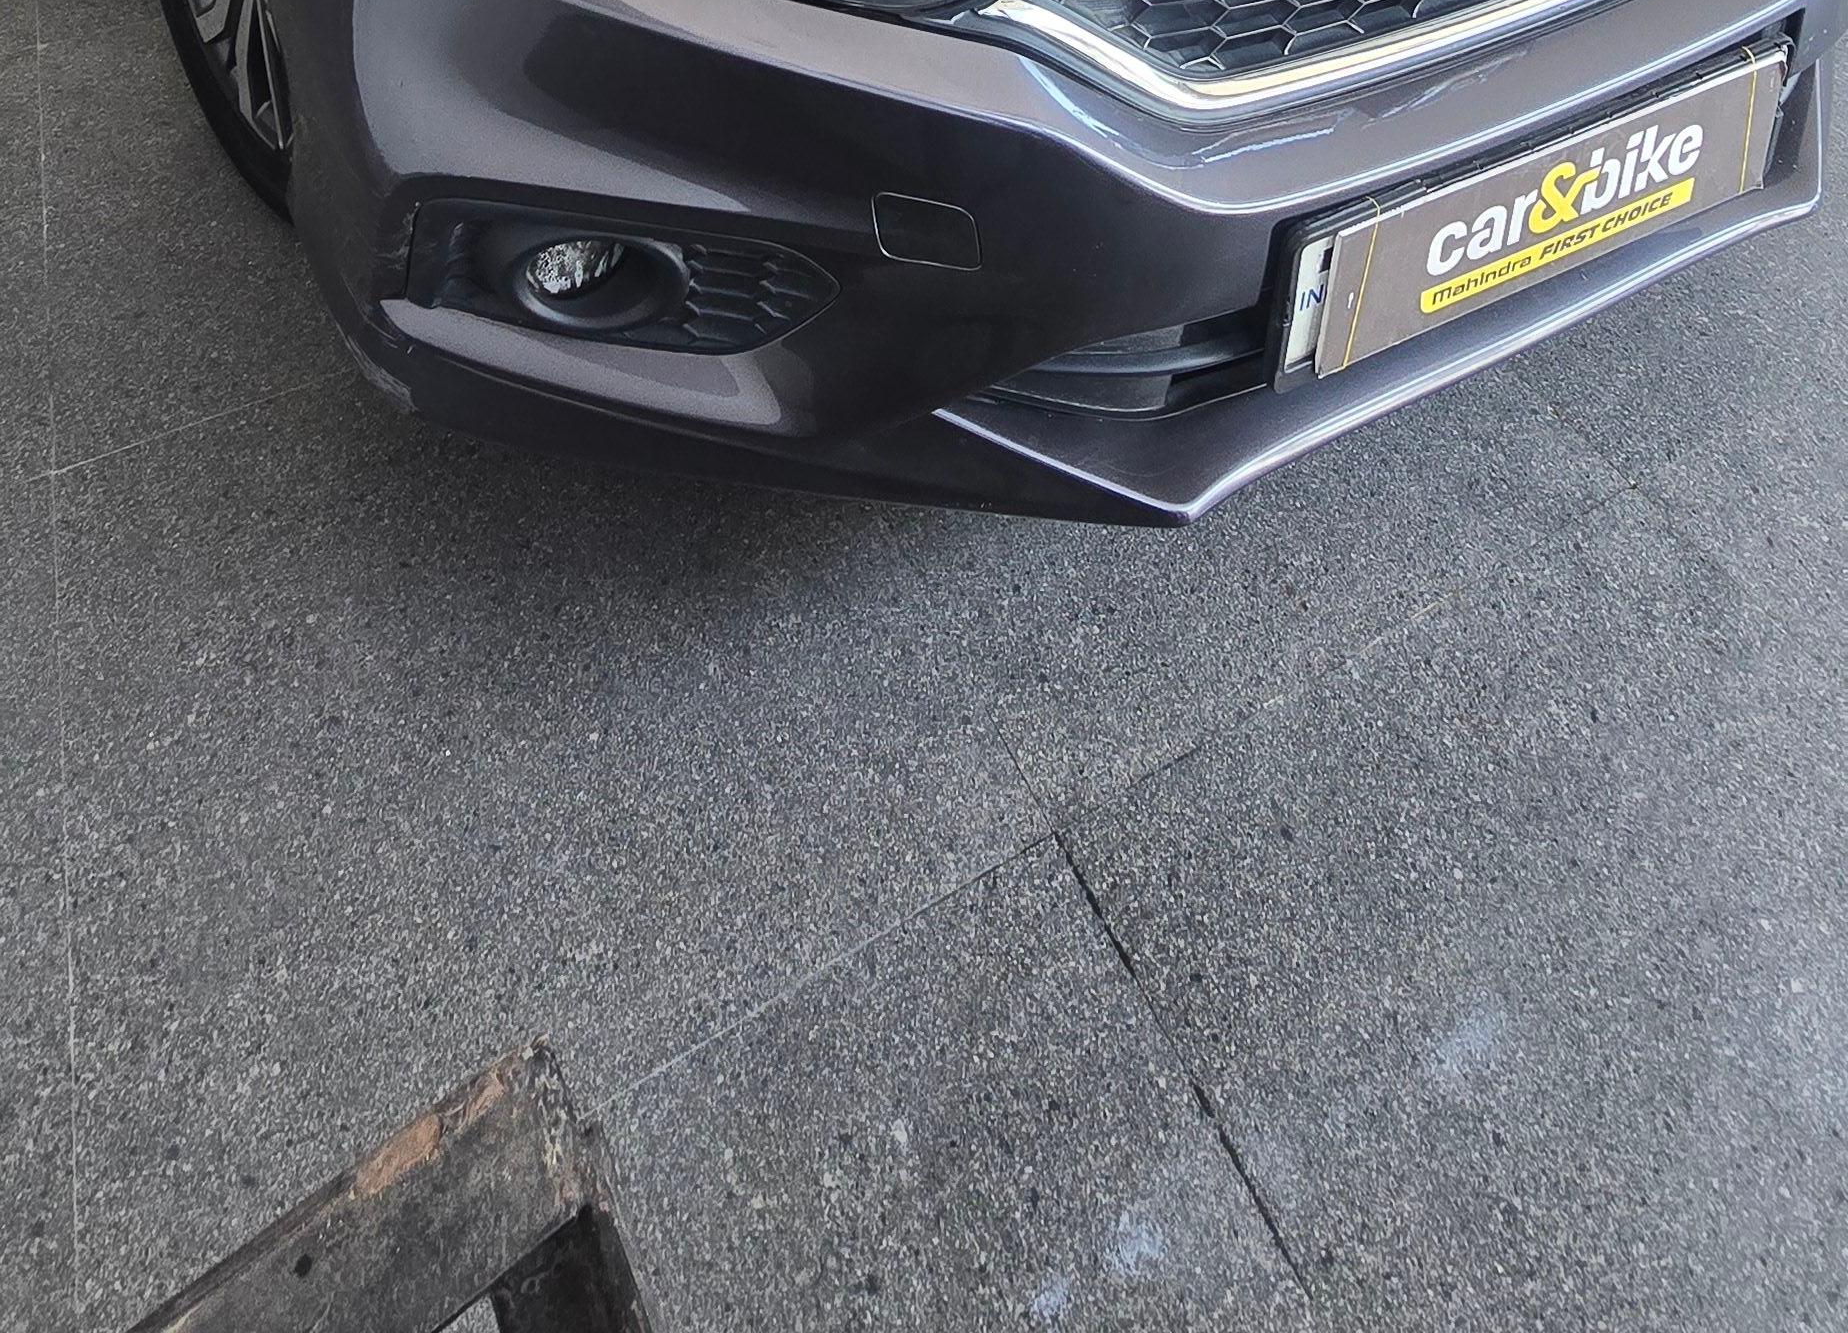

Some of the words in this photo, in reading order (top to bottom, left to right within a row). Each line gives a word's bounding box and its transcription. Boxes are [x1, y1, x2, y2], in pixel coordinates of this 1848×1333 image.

[1426, 124, 1704, 277] car&bike
[1431, 255, 1533, 306] Mahindra
[1538, 223, 1601, 261] FIRST
[1601, 191, 1674, 233] CHOICE
